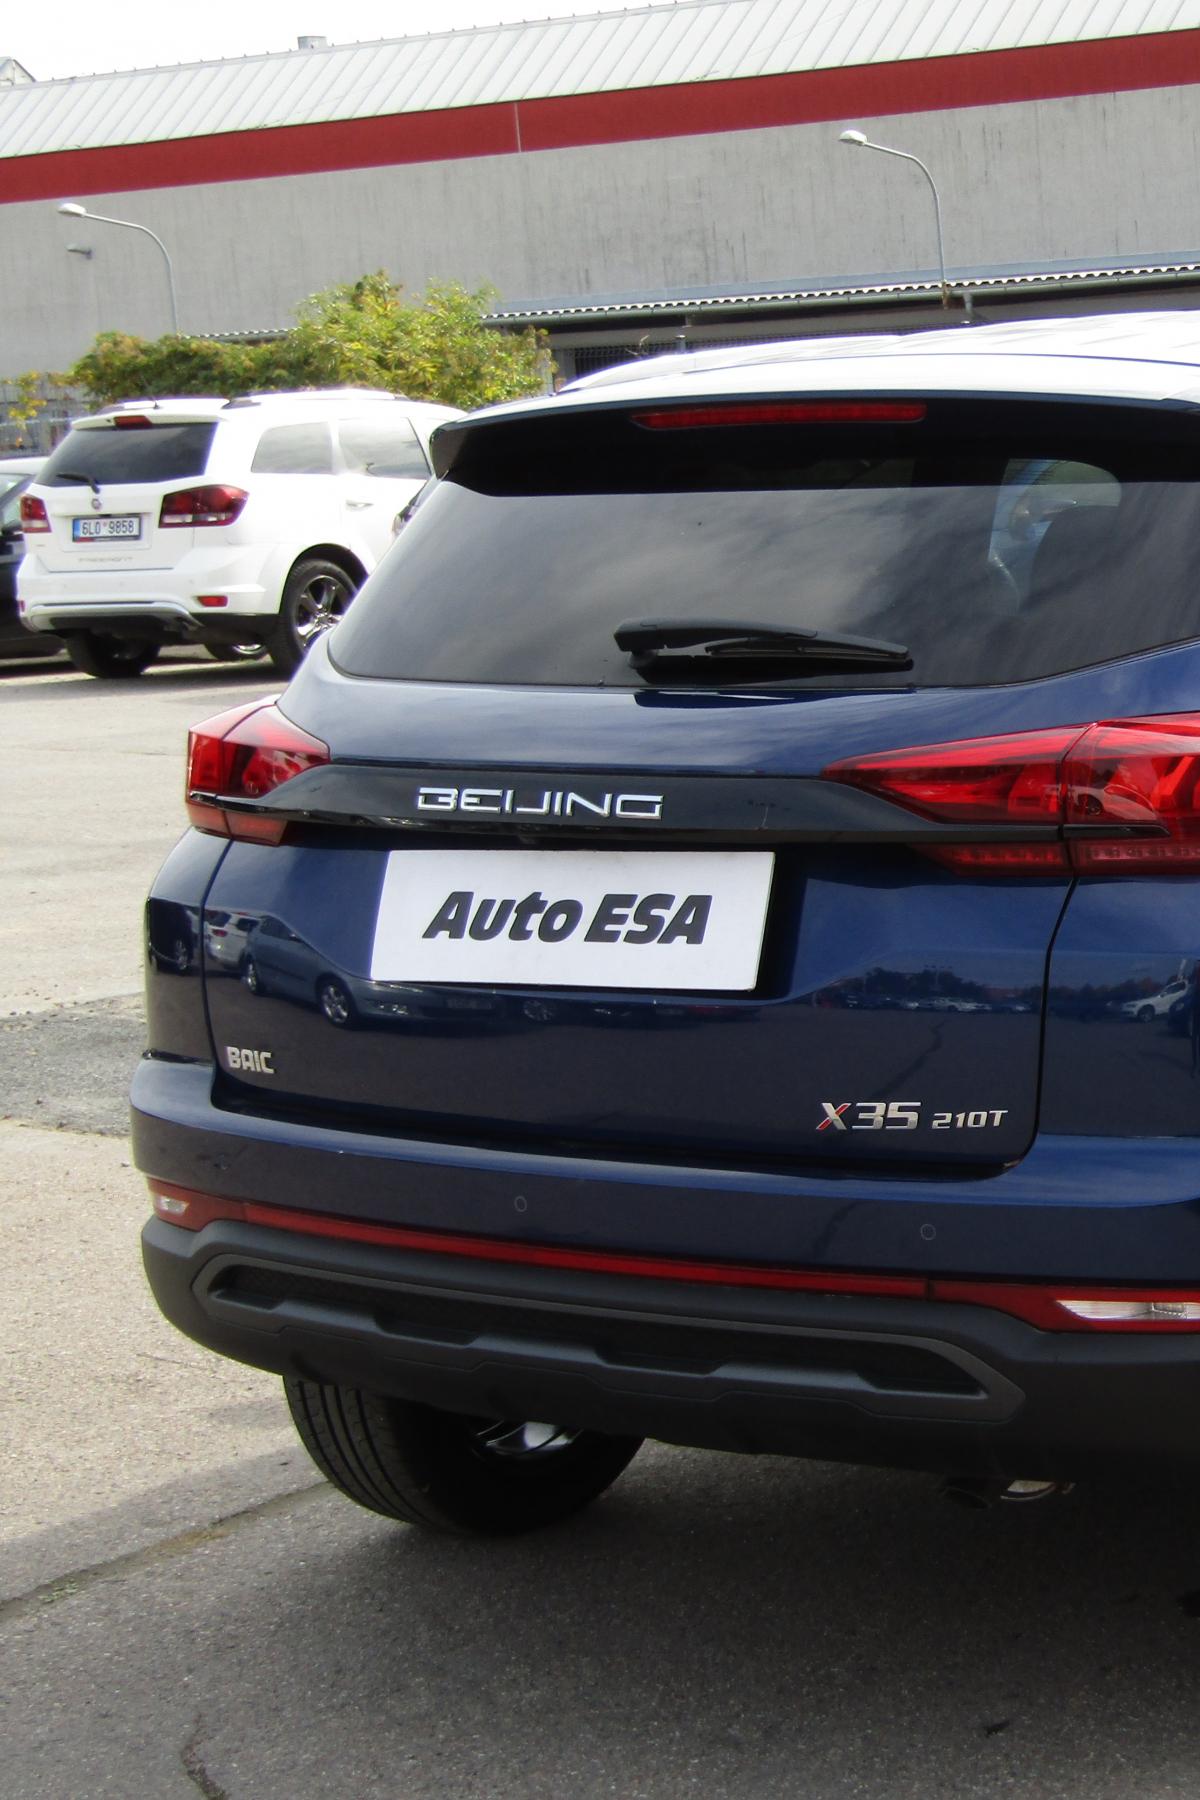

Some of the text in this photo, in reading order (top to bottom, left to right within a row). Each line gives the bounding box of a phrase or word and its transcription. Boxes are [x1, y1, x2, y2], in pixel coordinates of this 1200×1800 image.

[417, 787, 664, 820] BEIJING
[421, 891, 713, 945] Auto ESA
[226, 1046, 275, 1074] BAIC
[816, 1102, 1009, 1130] X35 210T
